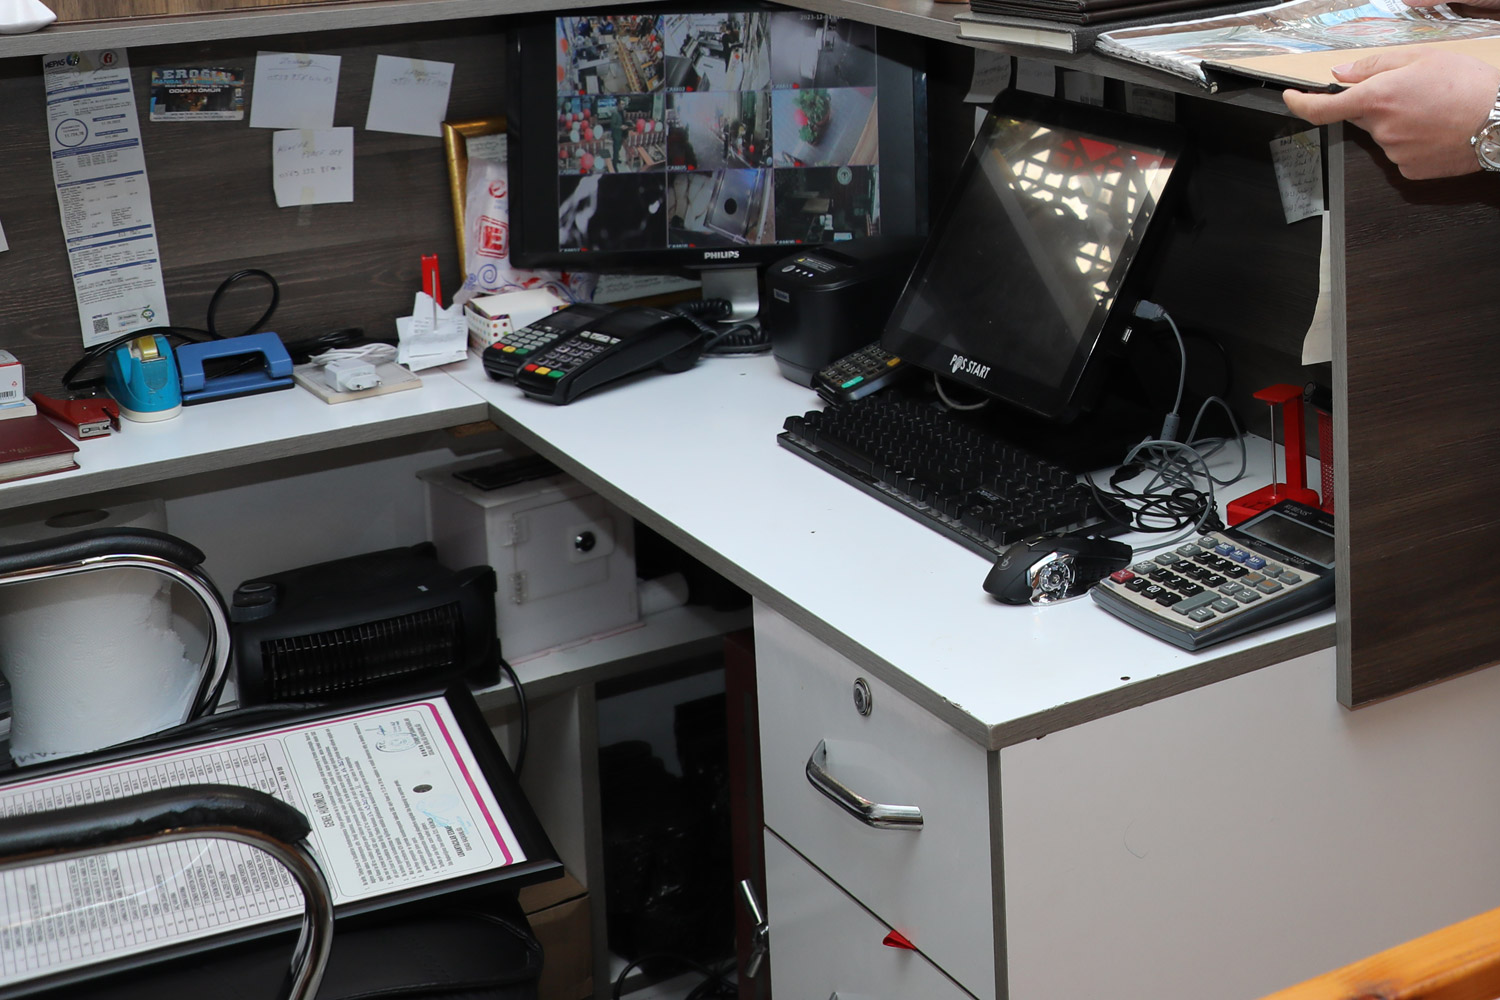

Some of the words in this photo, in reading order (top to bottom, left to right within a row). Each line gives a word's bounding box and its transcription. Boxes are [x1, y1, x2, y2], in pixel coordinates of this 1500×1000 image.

[704, 251, 739, 260] PHILIPS
[966, 363, 991, 379] START
[321, 813, 335, 828] GENEL
